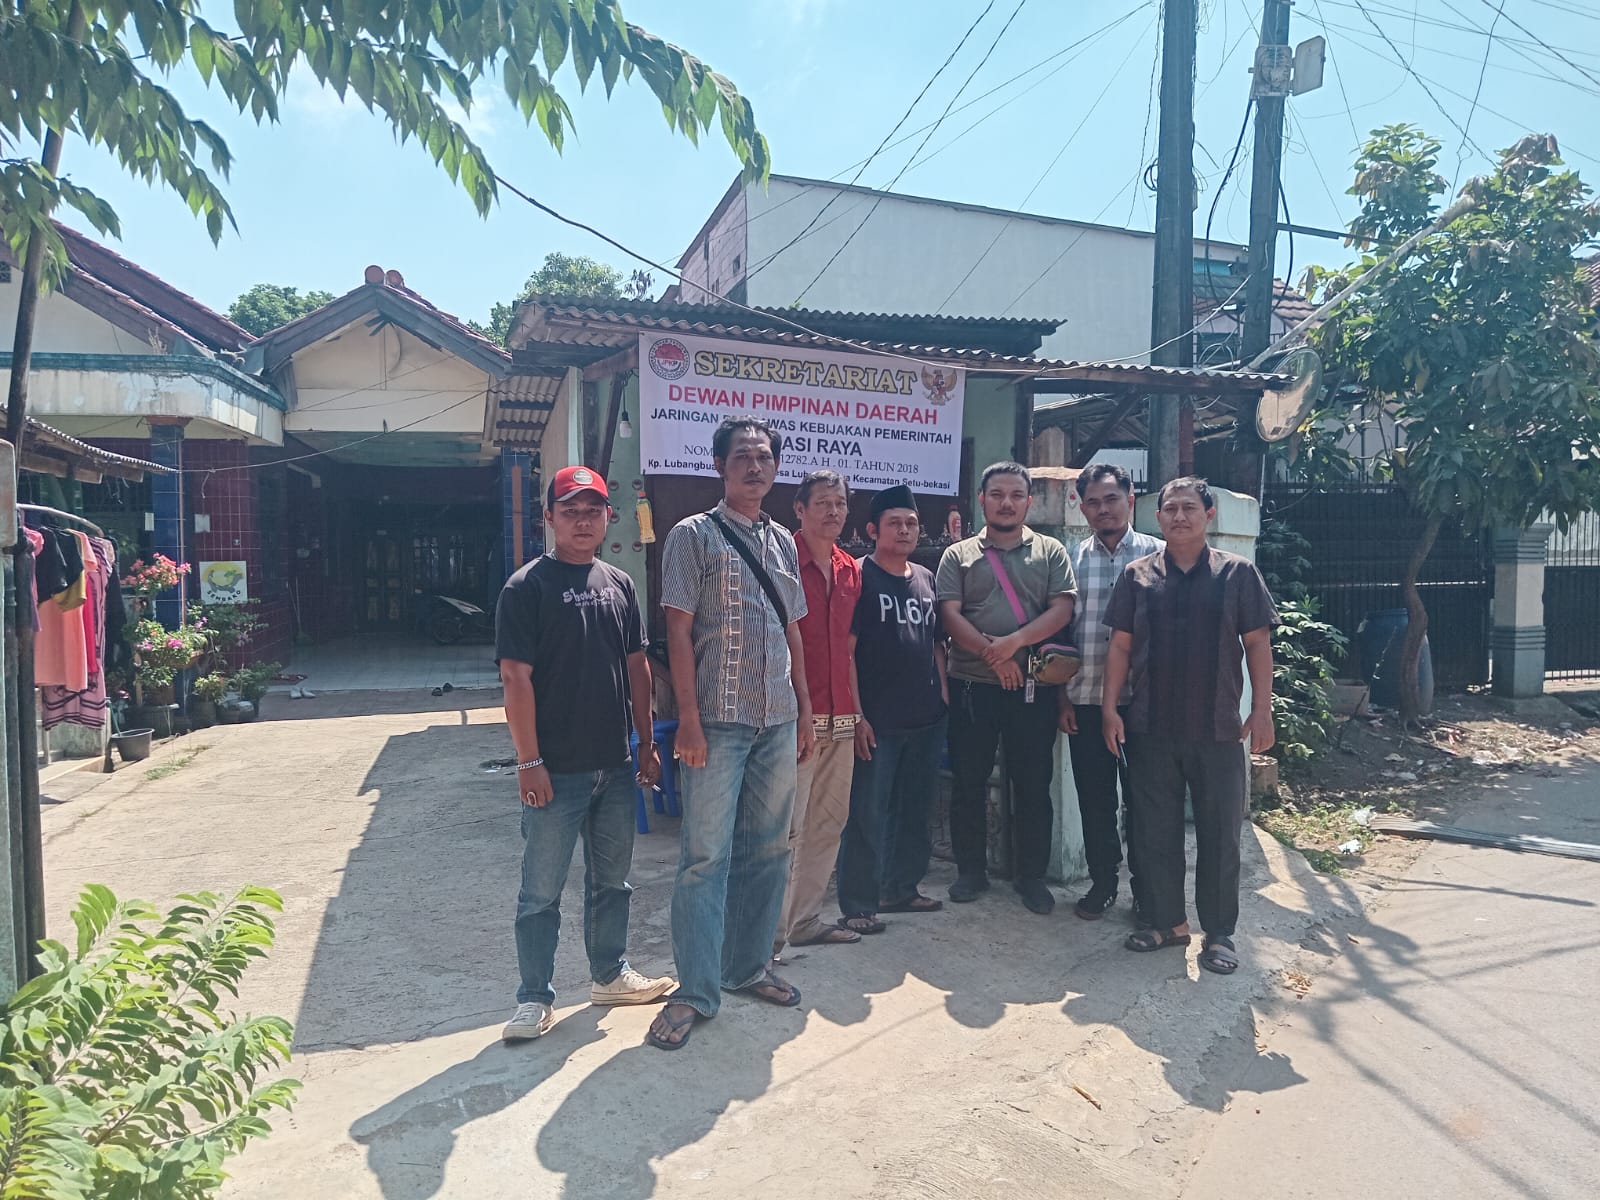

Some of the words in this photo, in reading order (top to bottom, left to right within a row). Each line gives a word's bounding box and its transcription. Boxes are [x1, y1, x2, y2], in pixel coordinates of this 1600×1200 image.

[695, 350, 917, 395] SEKRETARIAT
[668, 384, 745, 408] DEWAN
[752, 393, 850, 419] PIMPINAN
[856, 403, 938, 425] DAERAH
[651, 407, 719, 424] JARINGAN
[799, 421, 871, 439] KEBIJAKAN
[874, 427, 953, 445] PEMERINTAH
[684, 444, 714, 457] NOM
[854, 460, 896, 473] TAHUN
[897, 463, 920, 474] 2018
[781, 438, 811, 455] ASI
[817, 440, 863, 456] RAYA
[648, 459, 662, 469] Kp.
[664, 459, 717, 471] Lubangbua
[852, 474, 900, 486] Kecamatan
[902, 478, 951, 490] Setu-bekasi
[207, 591, 240, 601] SEMBAKO
